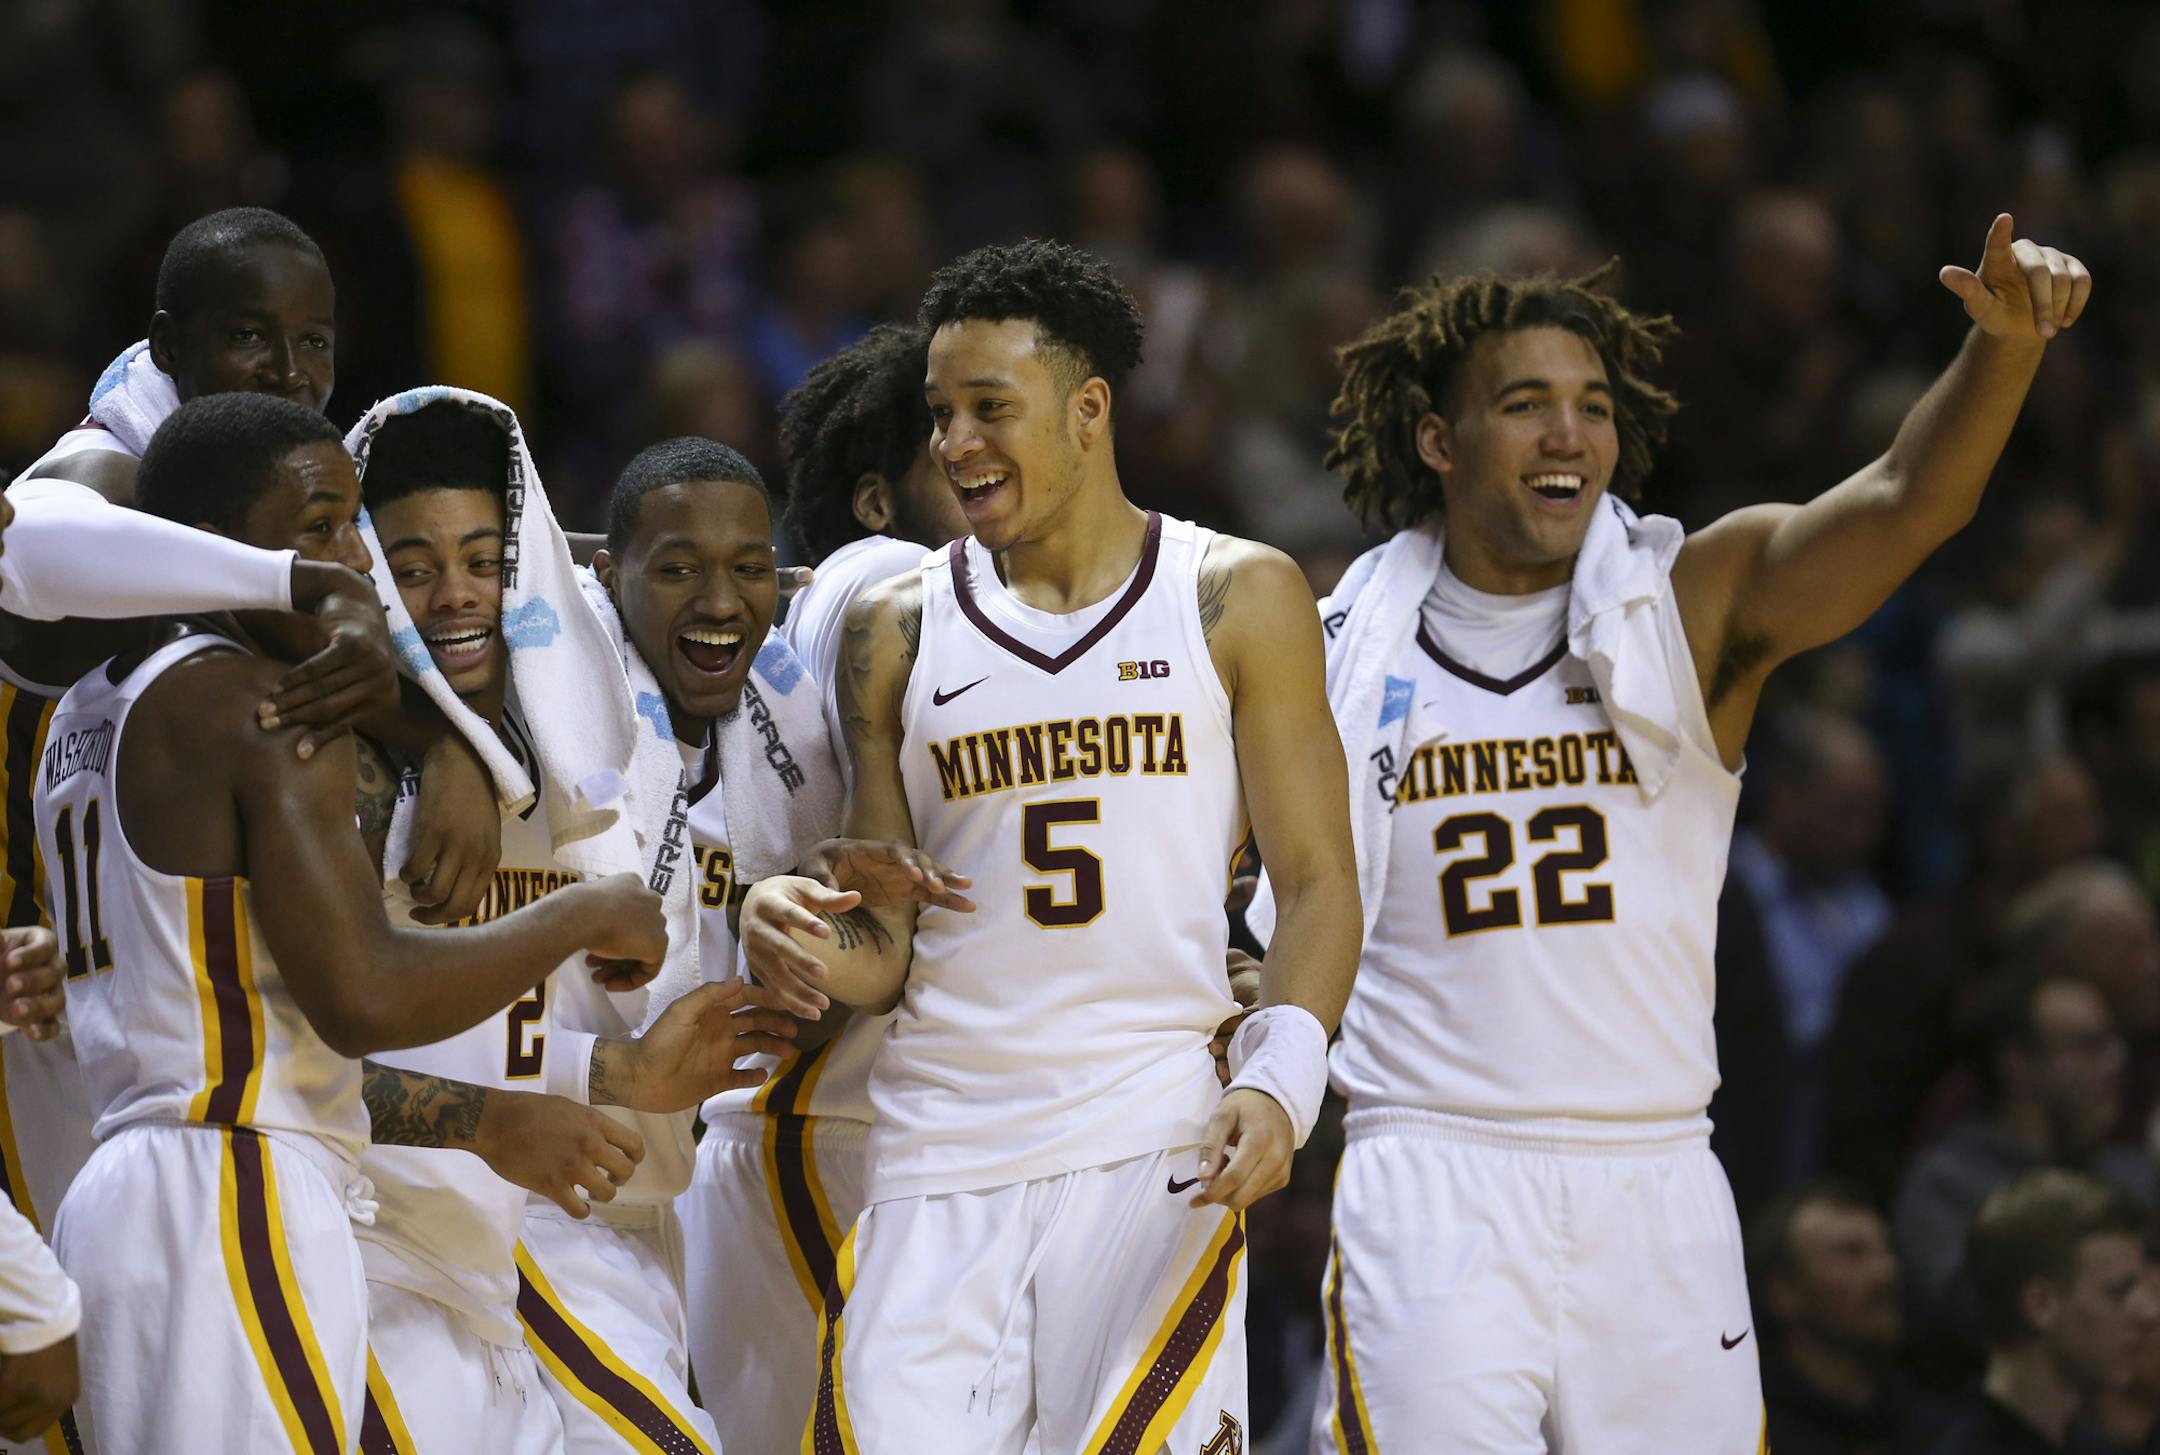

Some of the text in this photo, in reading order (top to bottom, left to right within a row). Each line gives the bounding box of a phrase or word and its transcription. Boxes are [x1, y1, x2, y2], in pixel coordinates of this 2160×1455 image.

[928, 712, 1189, 803] MINNESOTA
[55, 796, 115, 984] 11
[1021, 797, 1106, 930] 5
[1432, 803, 1616, 940] 22
[504, 977, 546, 1081] 2
